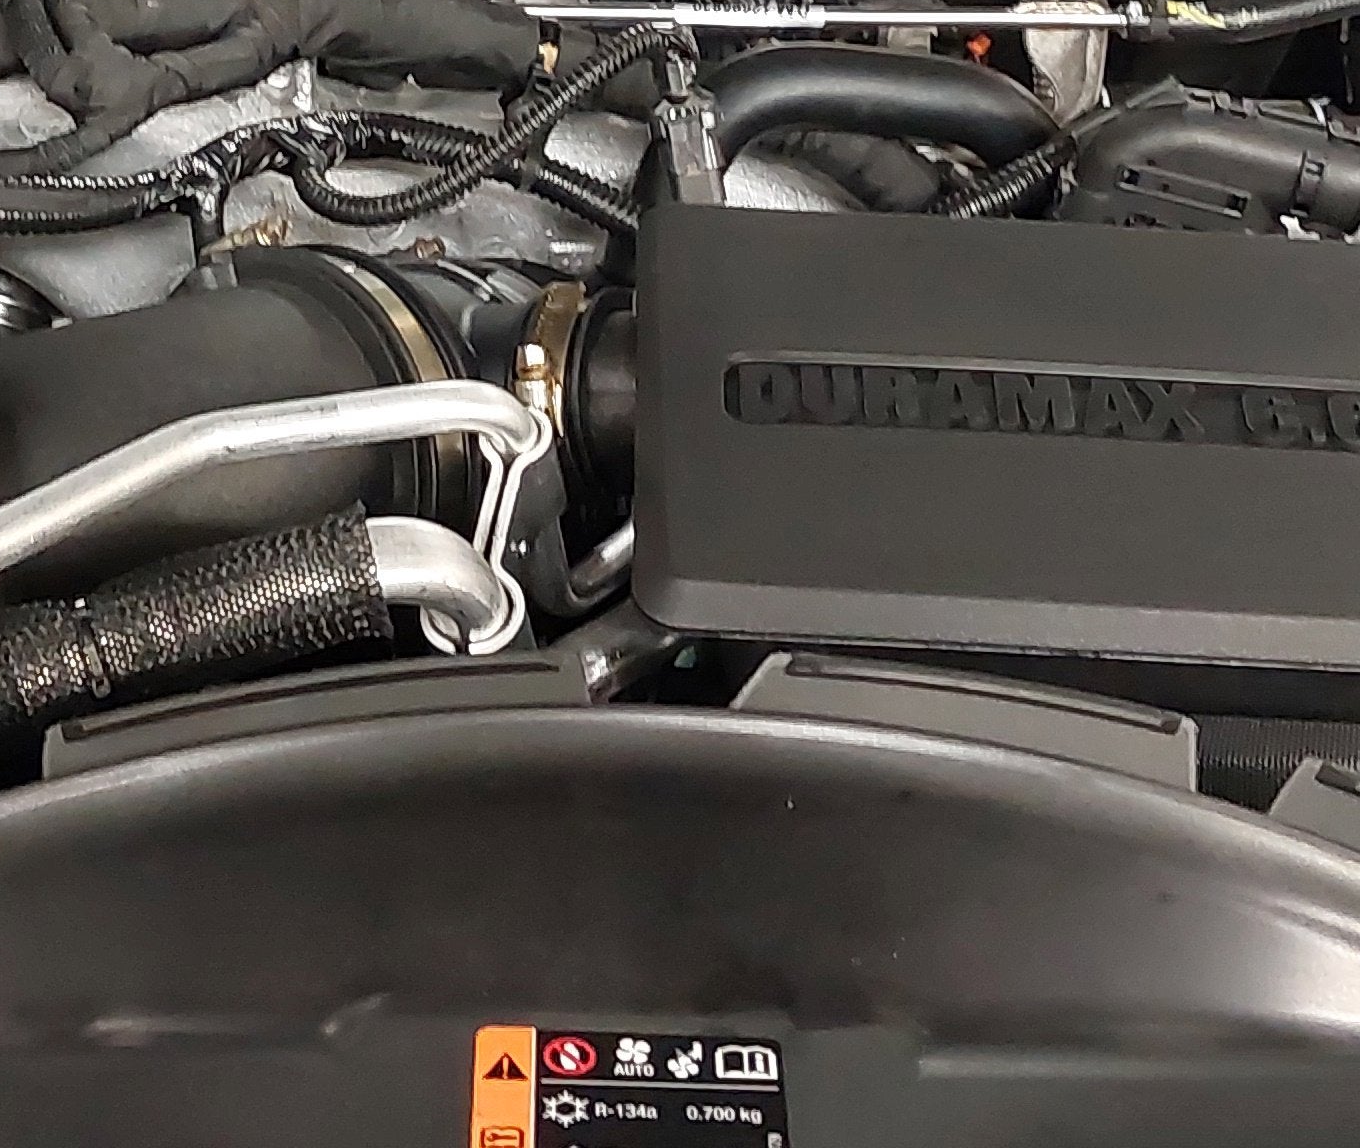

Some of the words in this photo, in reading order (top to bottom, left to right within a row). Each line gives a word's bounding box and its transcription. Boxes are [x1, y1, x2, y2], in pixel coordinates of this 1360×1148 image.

[738, 363, 1205, 442] DURAMAX
[613, 1063, 655, 1078] AUTO
[594, 1101, 658, 1121] R-134a
[685, 1104, 736, 1122] 0.700
[739, 1105, 763, 1125] kg
